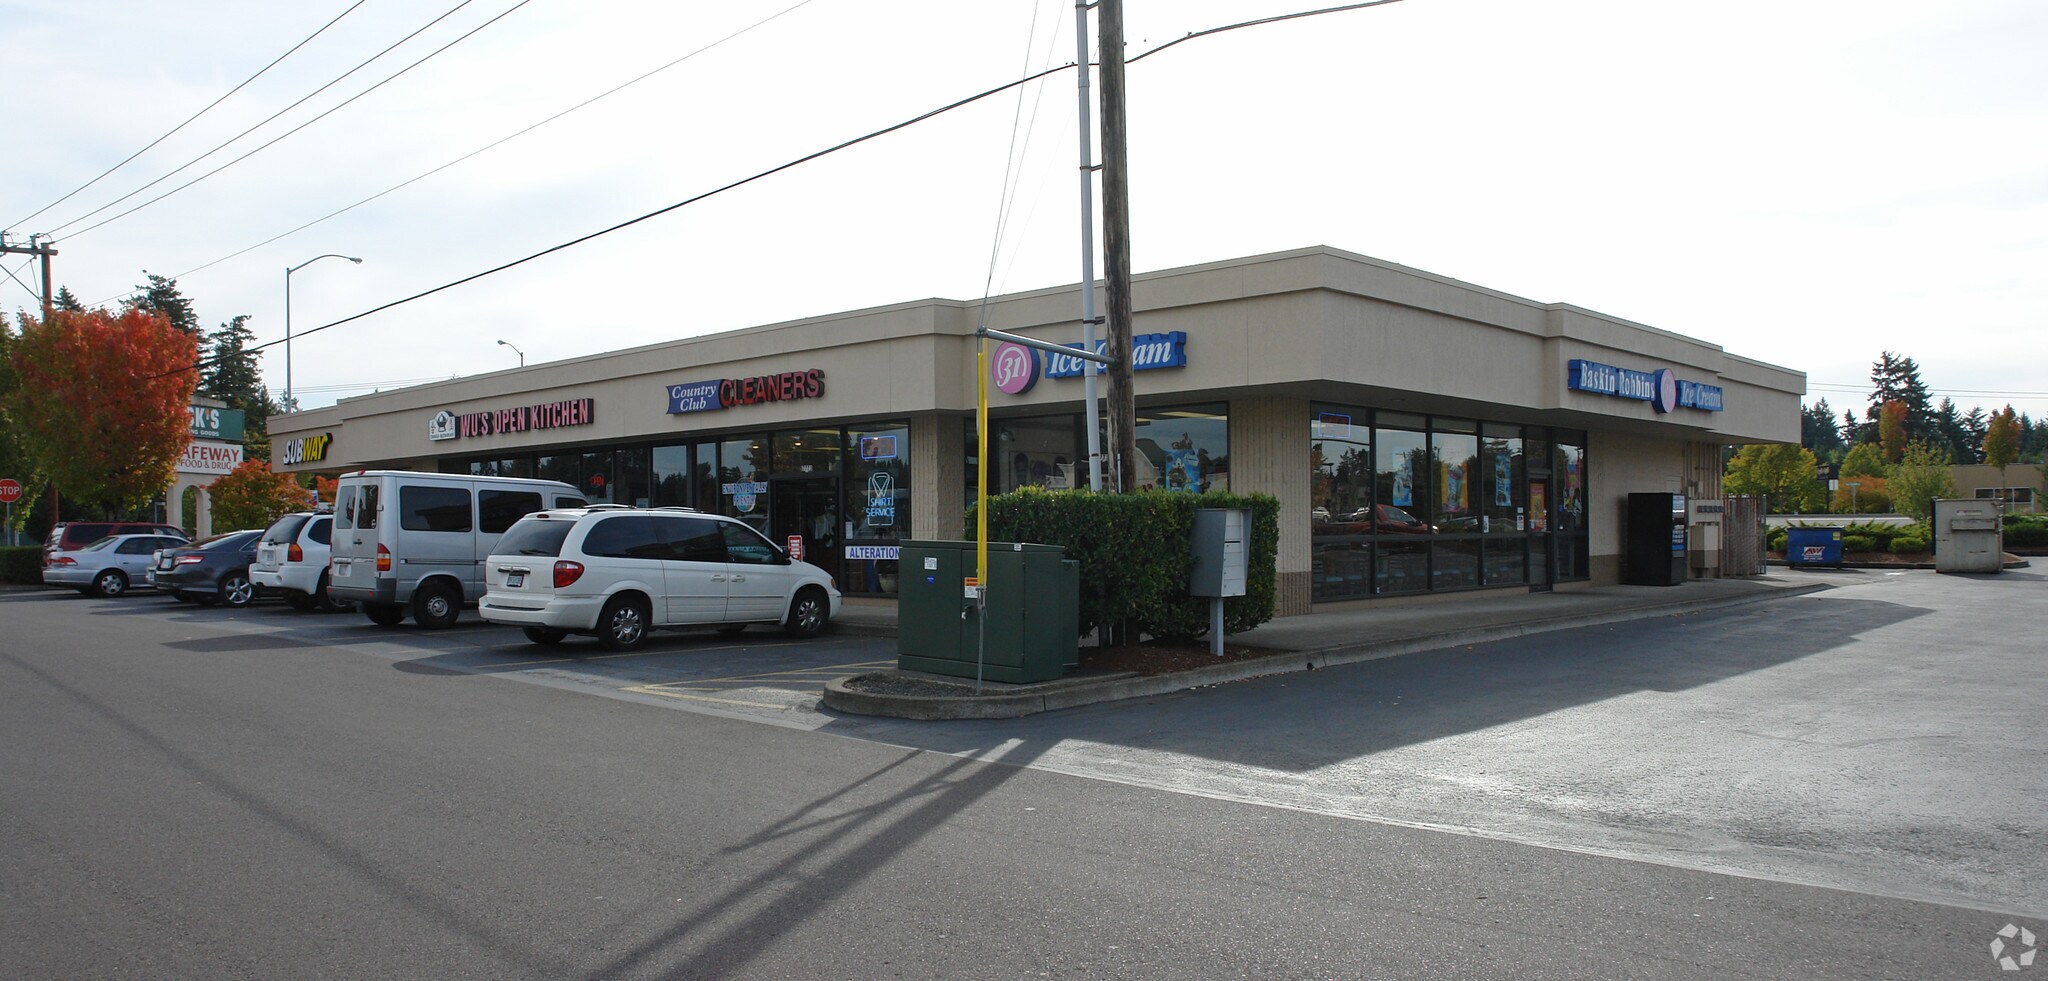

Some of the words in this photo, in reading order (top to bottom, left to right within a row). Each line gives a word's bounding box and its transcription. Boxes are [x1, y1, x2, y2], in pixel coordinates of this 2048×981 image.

[997, 354, 1023, 387] 31
[1049, 350, 1083, 375] Ice
[720, 368, 819, 407] CLEANERS
[1581, 363, 1615, 391] Baskin
[1619, 371, 1655, 399] Robbins
[672, 384, 716, 398] Country
[1681, 383, 1694, 404] Ice
[1697, 385, 1721, 408] Cream
[680, 397, 706, 411] Club
[187, 407, 220, 429] CK'S
[460, 412, 489, 437] WU'S
[493, 406, 526, 433] OPEN
[530, 398, 588, 429] KITCHEN
[181, 446, 239, 462] AFEWAY
[283, 433, 329, 464] SUBWAY
[180, 459, 203, 468] FOOD
[211, 462, 232, 470] DRUG
[0, 486, 20, 495] STOP
[870, 498, 892, 506] SHIRT
[866, 507, 895, 517] SERVICE
